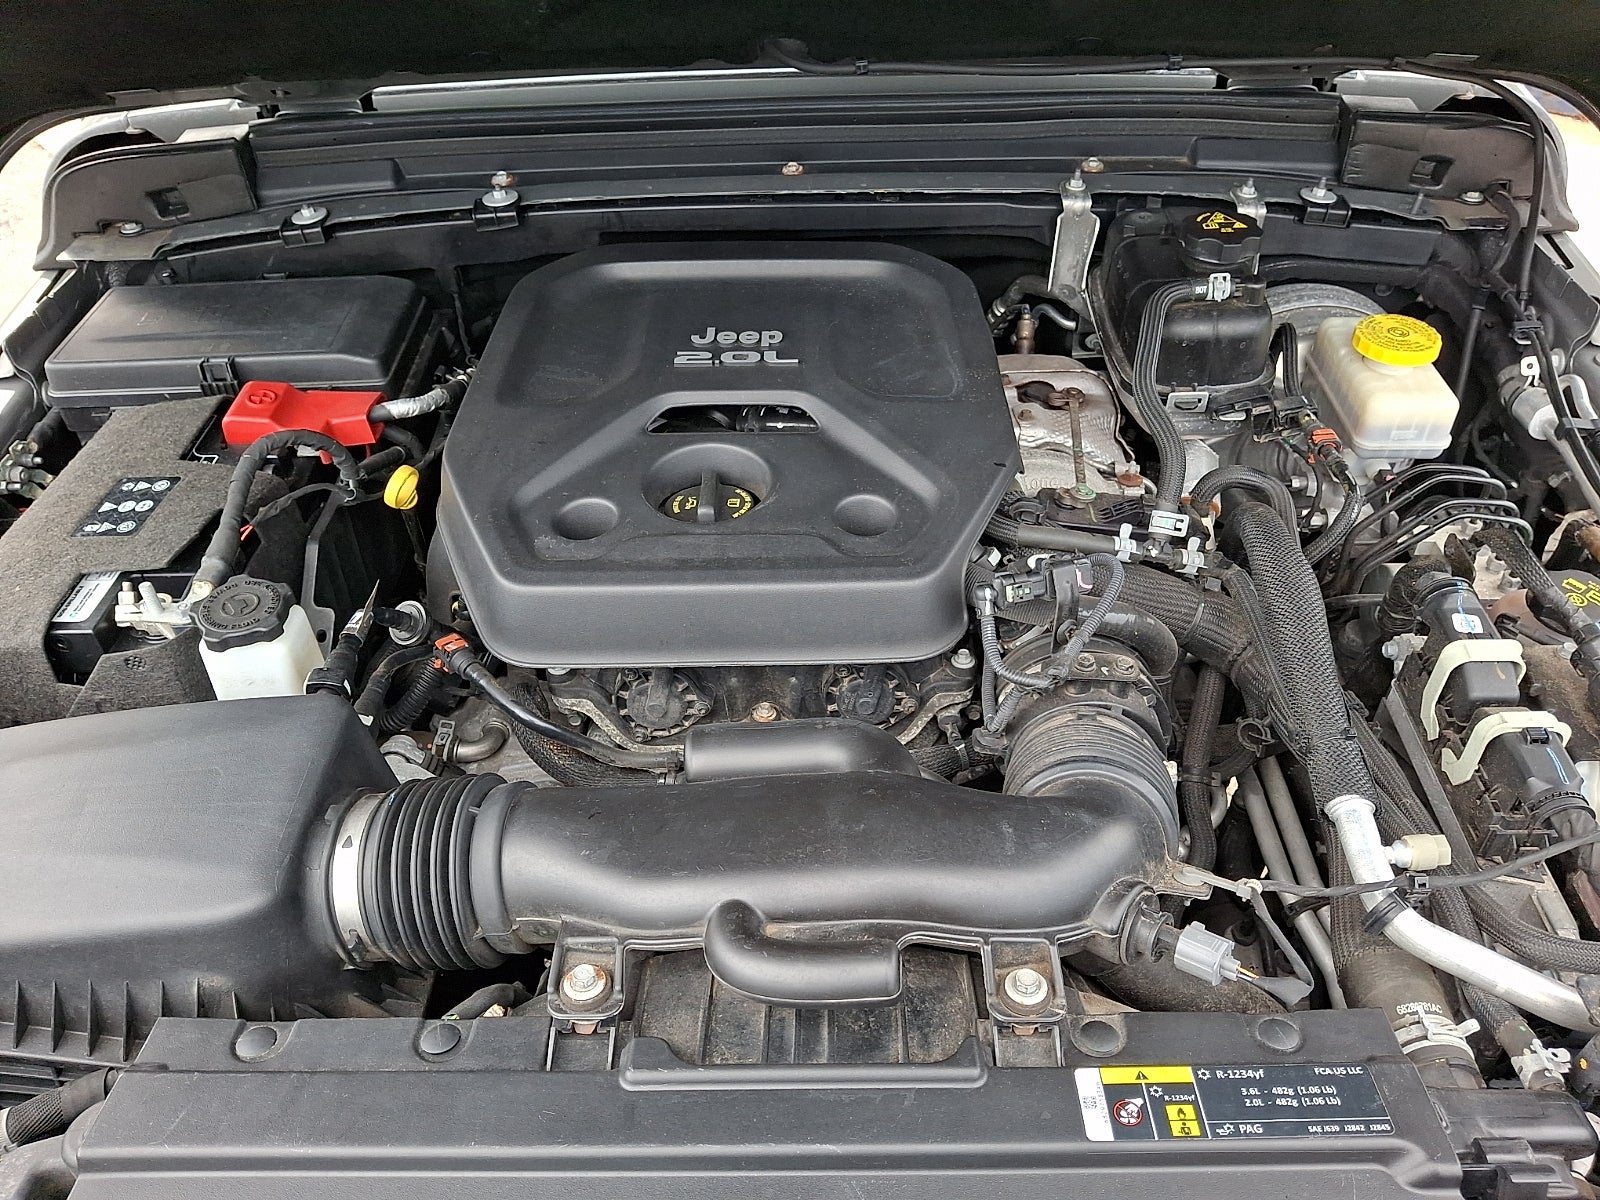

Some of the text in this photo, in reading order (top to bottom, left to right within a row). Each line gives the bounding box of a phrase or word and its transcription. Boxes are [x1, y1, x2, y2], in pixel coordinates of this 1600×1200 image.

[1195, 286, 1207, 294] BOT
[690, 326, 783, 348] Jeep
[673, 350, 799, 365] 2.0L
[1216, 1069, 1265, 1080] R-1234yf
[1347, 1066, 1364, 1075] LLC
[1241, 1087, 1261, 1096] 3.6L
[1271, 1086, 1294, 1097] 482g
[1297, 1085, 1319, 1096] (1.06
[1321, 1085, 1337, 1095] Lb)
[1164, 1094, 1195, 1103] R-1234yf
[1244, 1098, 1264, 1107] 2.0L
[1275, 1097, 1299, 1108] 482g
[1301, 1096, 1323, 1107] (1.06
[1239, 1124, 1263, 1134] PAG
